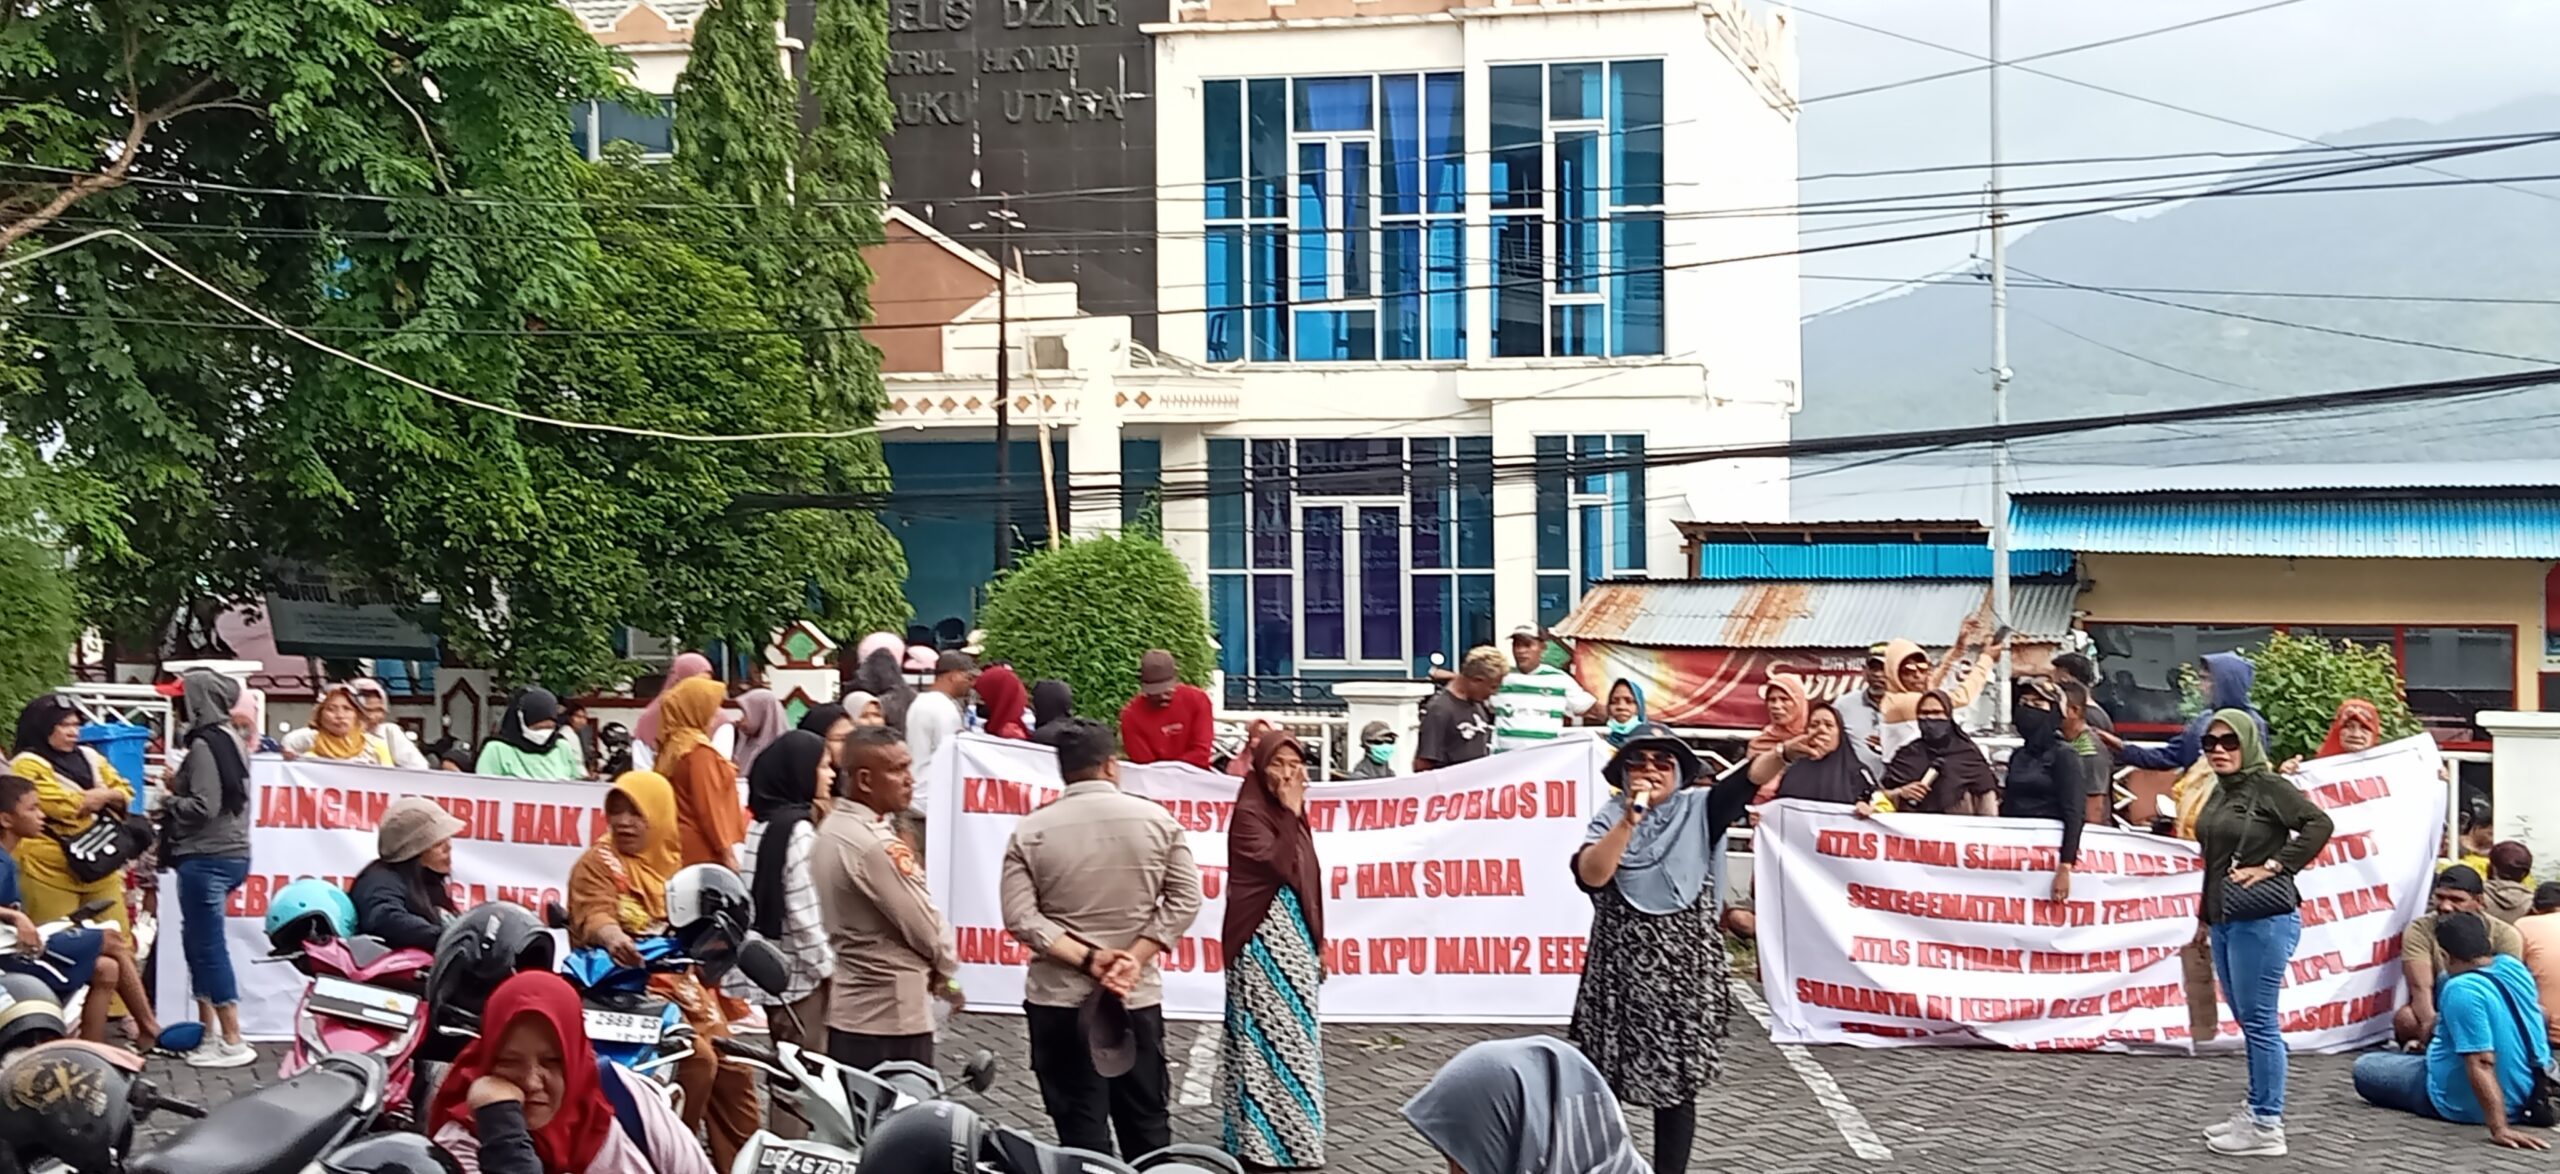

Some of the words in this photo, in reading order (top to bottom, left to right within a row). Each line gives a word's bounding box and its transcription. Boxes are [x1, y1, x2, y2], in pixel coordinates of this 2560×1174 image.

[255, 784, 390, 833] JANGAN
[511, 801, 583, 847] HAK
[962, 777, 1032, 816] KAMI
[1345, 797, 1419, 832] YANG
[1424, 781, 1538, 823] COBLOS
[1544, 780, 1577, 818] DI
[1816, 829, 1879, 861] ATAS
[1884, 834, 1959, 868] NAMA
[1356, 861, 1418, 899] HAK
[1422, 858, 1525, 898] SUARA
[1368, 936, 1428, 975] KPU
[1435, 936, 1532, 975] MAIN2
[1848, 935, 1910, 966] ATAS
